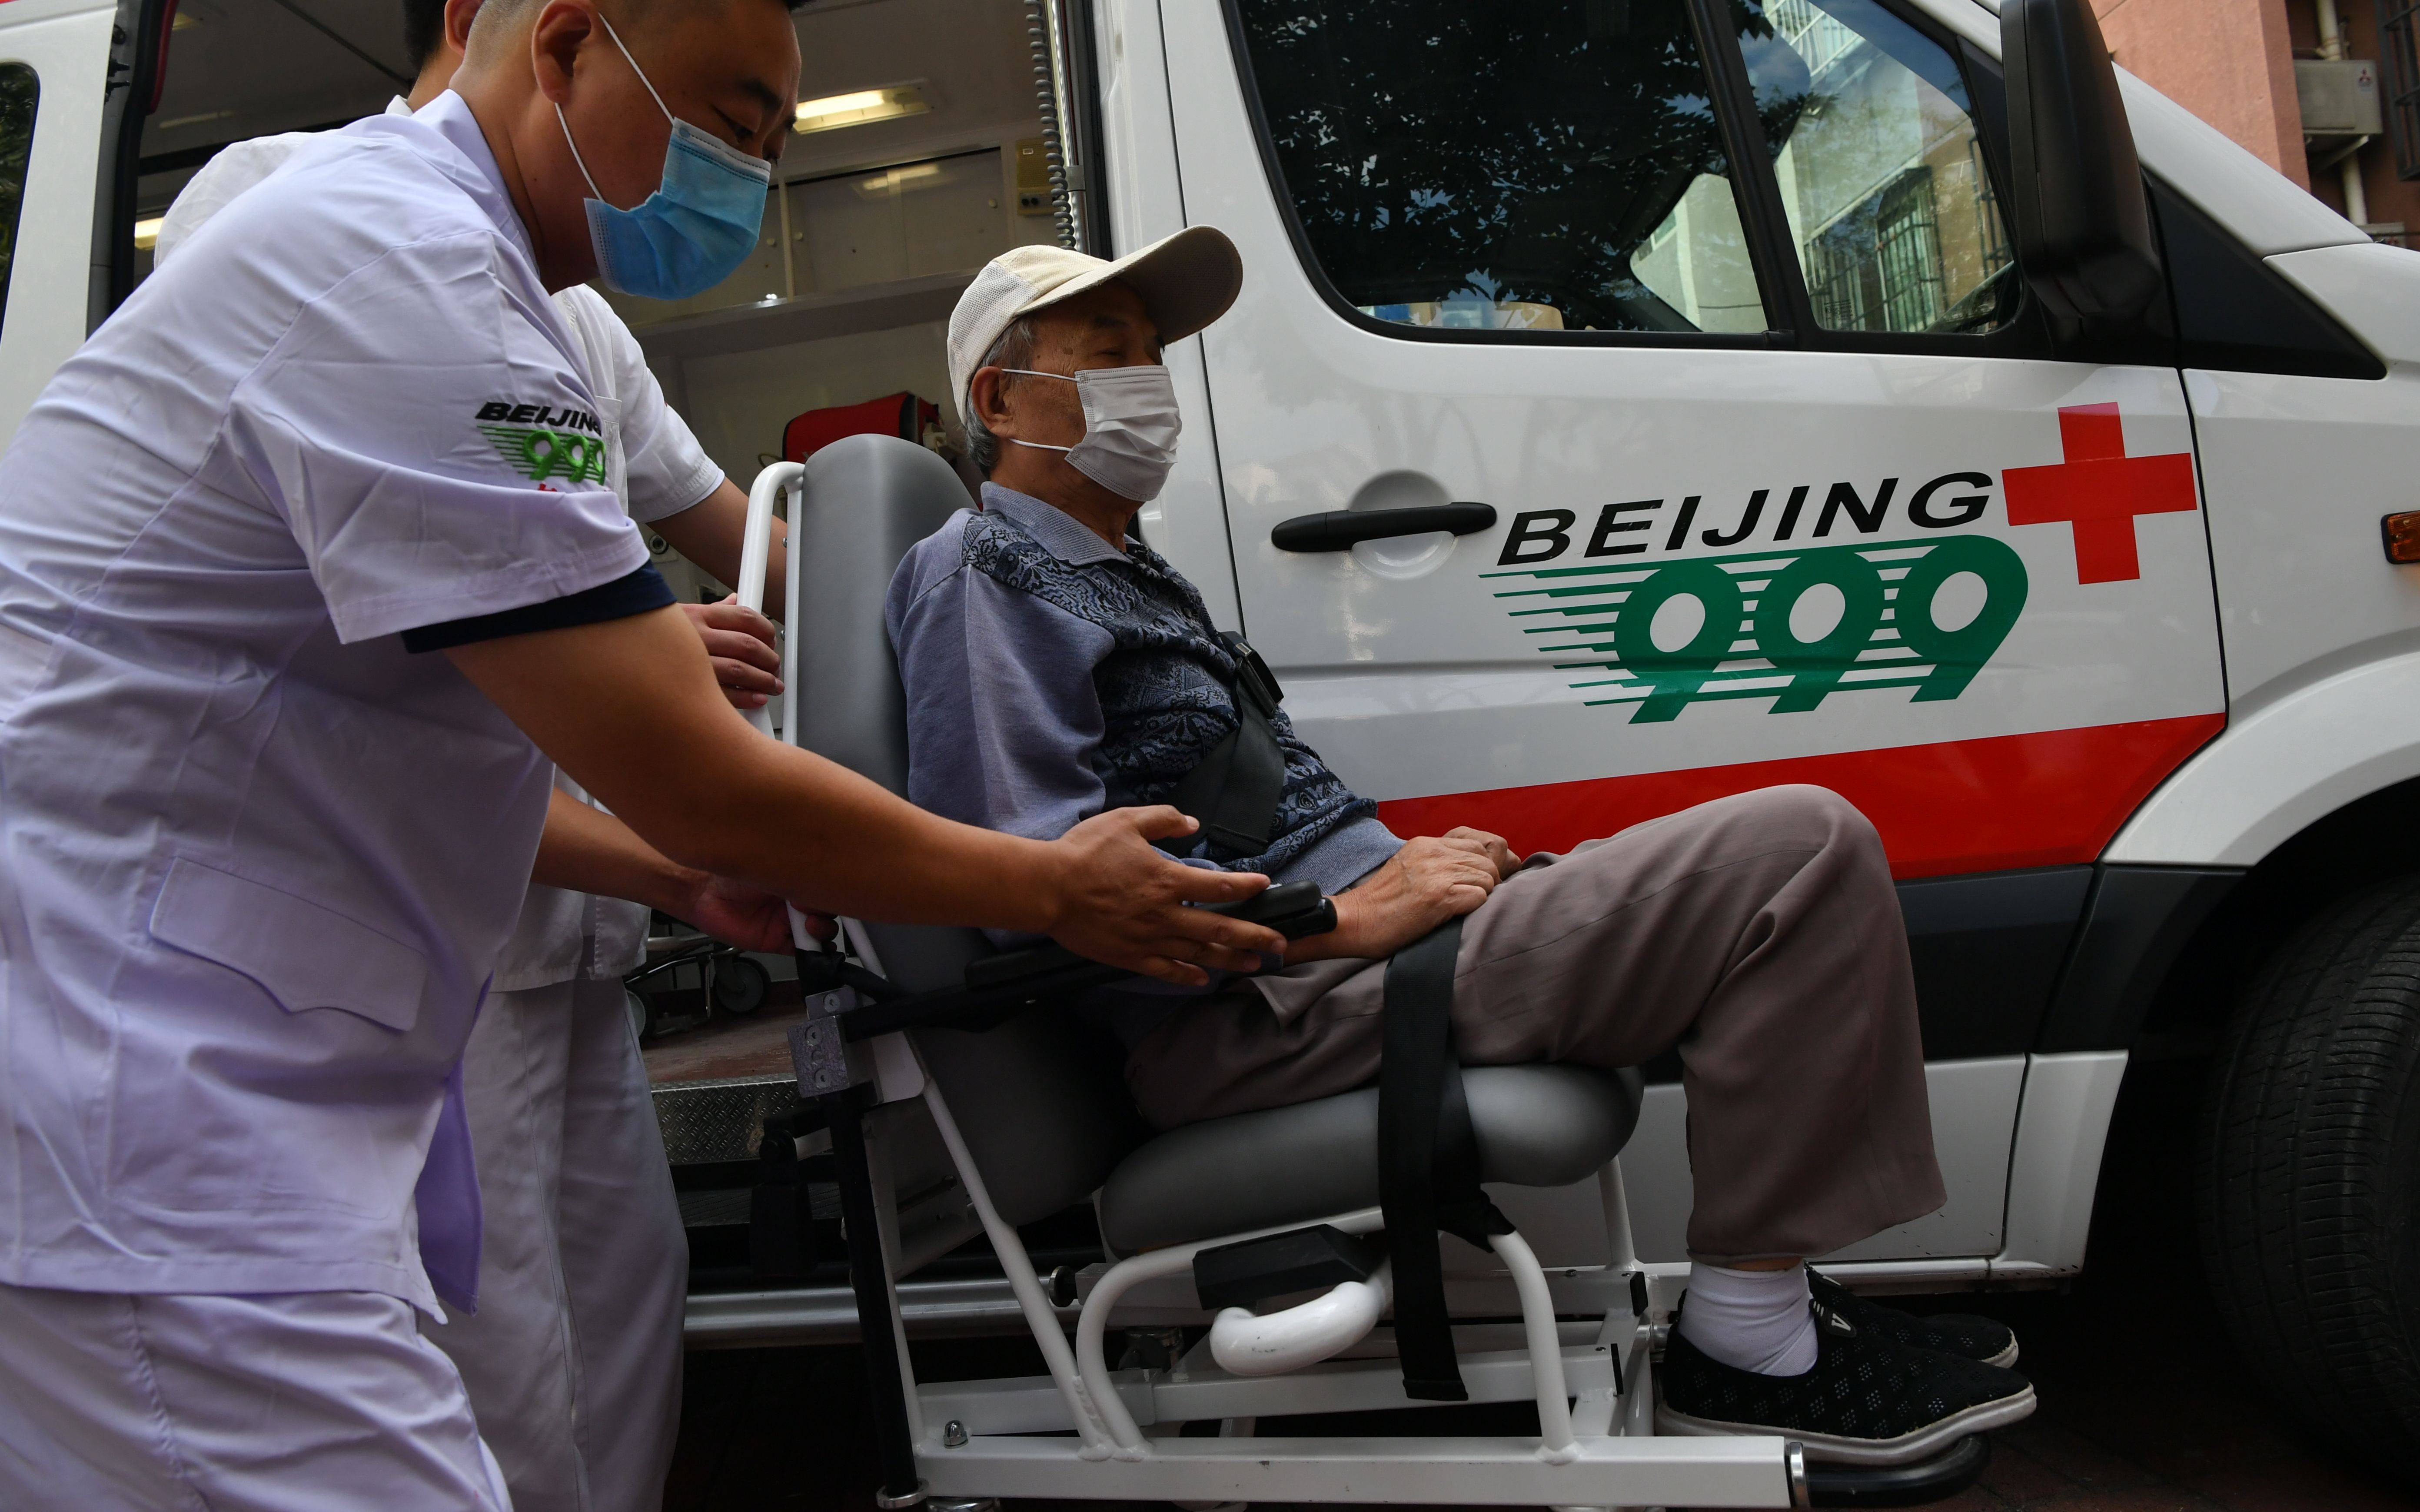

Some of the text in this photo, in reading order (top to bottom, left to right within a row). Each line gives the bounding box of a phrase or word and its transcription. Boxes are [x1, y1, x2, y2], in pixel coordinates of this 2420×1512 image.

[522, 430, 605, 485] 999
[1497, 472, 1993, 566] BEIJING
[1614, 535, 2028, 724] 999
